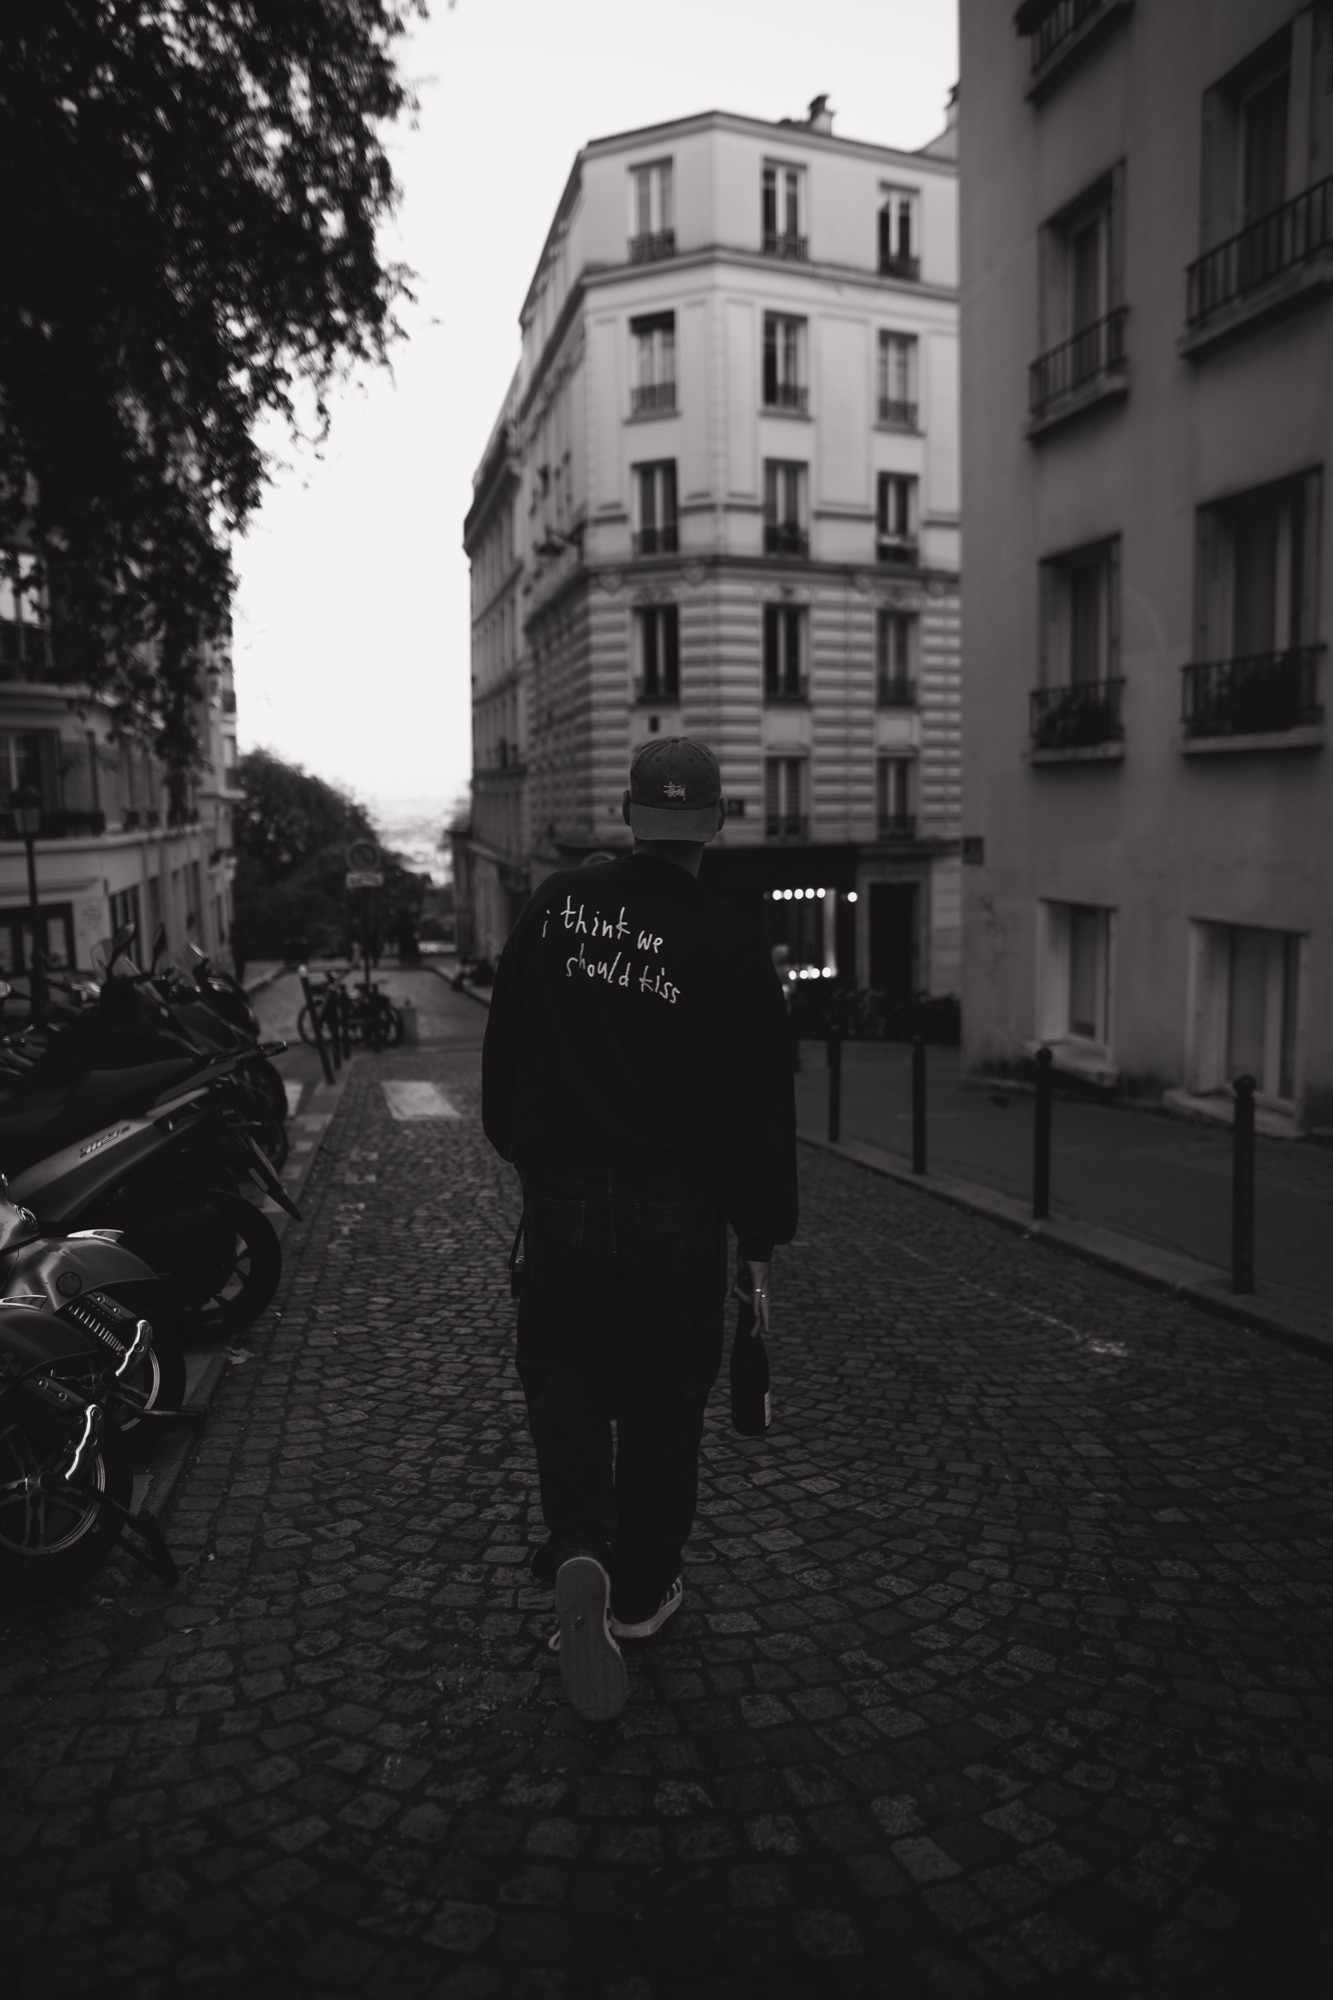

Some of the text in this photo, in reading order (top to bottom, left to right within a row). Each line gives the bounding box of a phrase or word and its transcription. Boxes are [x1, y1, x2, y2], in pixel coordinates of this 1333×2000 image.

[541, 894, 664, 954] i think we
[565, 942, 682, 1004] should kiss
